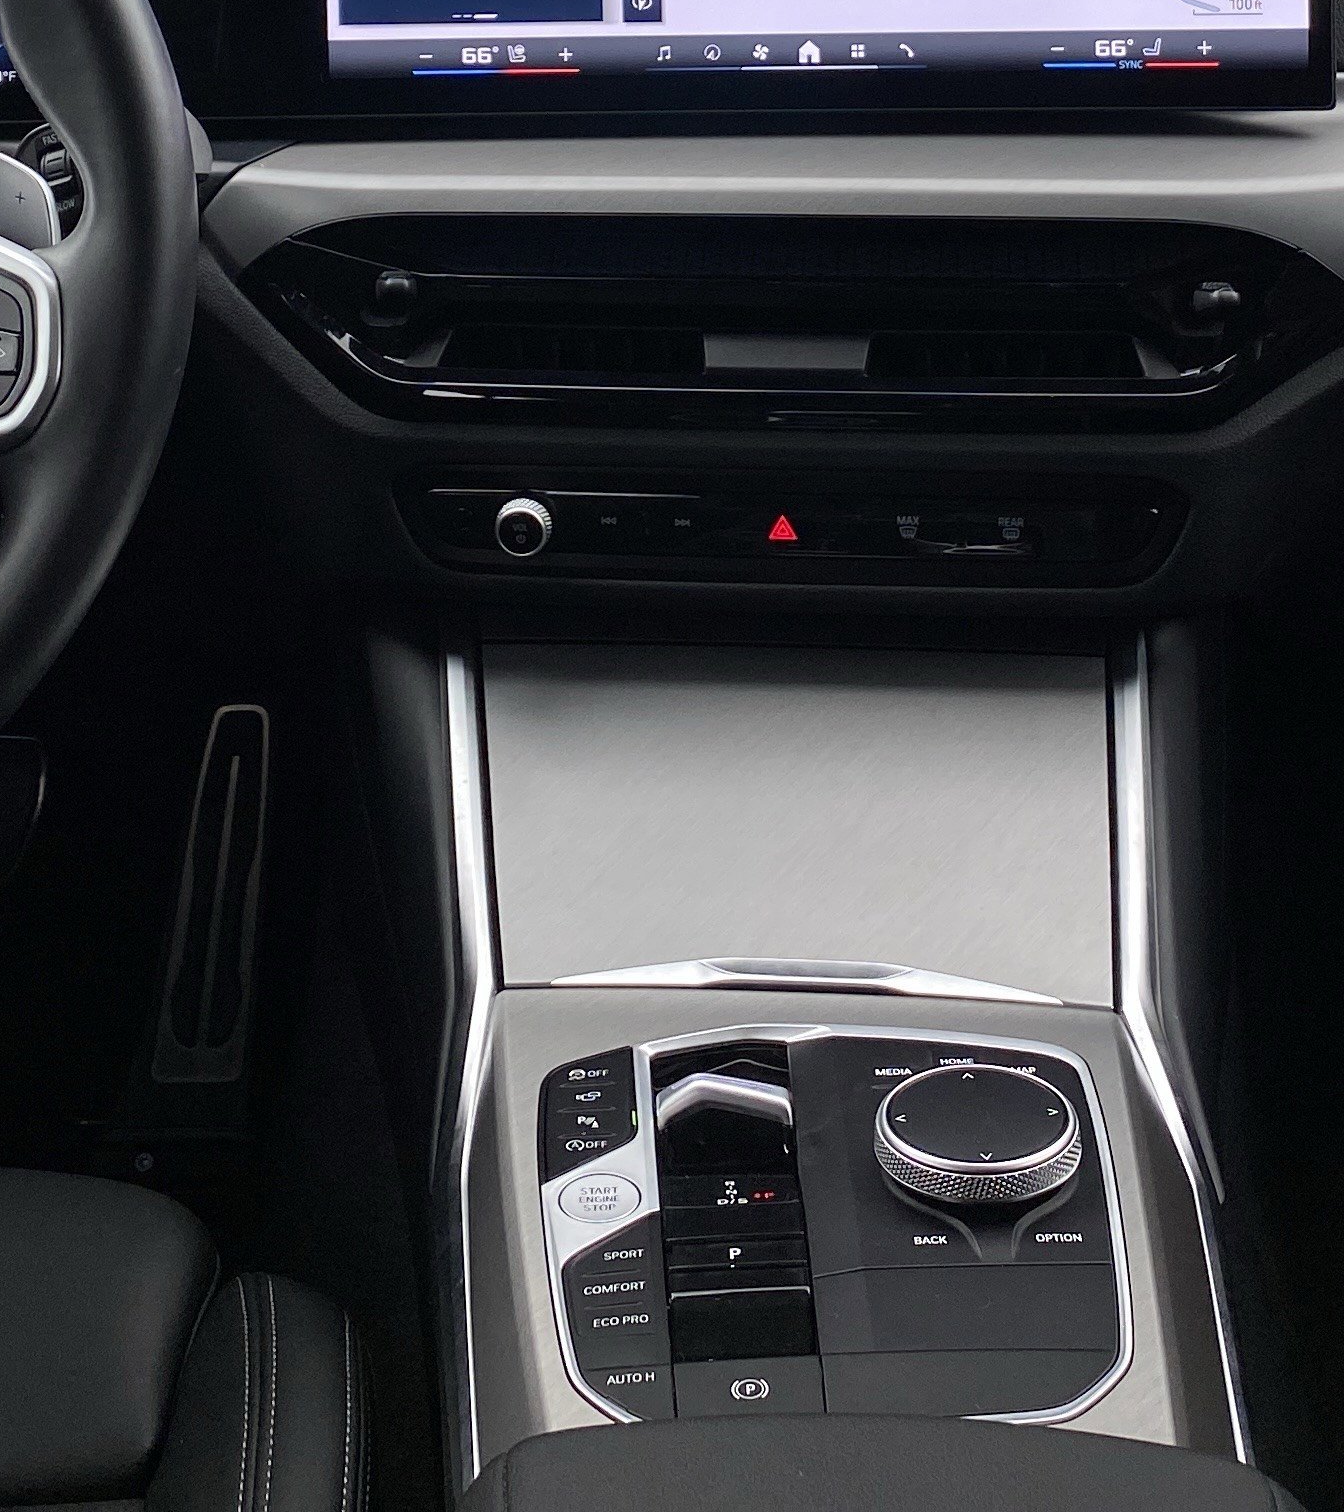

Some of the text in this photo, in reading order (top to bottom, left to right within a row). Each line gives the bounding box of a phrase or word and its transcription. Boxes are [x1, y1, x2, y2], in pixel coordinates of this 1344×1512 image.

[1254, 0, 1263, 10] ft
[1118, 59, 1144, 70] SYNC
[42, 133, 58, 146] FAS
[896, 515, 920, 526] MAX
[997, 516, 1025, 528] REAR
[587, 1069, 609, 1078] OFF
[874, 1067, 913, 1077] MEDIA
[585, 1140, 608, 1149] OFF
[580, 1187, 618, 1196] START
[578, 1195, 619, 1204] ENGINE
[583, 1203, 617, 1212] STOP
[913, 1235, 948, 1245] BACK
[1035, 1232, 1083, 1243] OPTION
[603, 1248, 644, 1261] SPORT
[729, 1247, 742, 1260] P
[583, 1281, 646, 1296] COMFORT
[592, 1314, 649, 1329] ECO PRO
[606, 1371, 655, 1386] AUTO H
